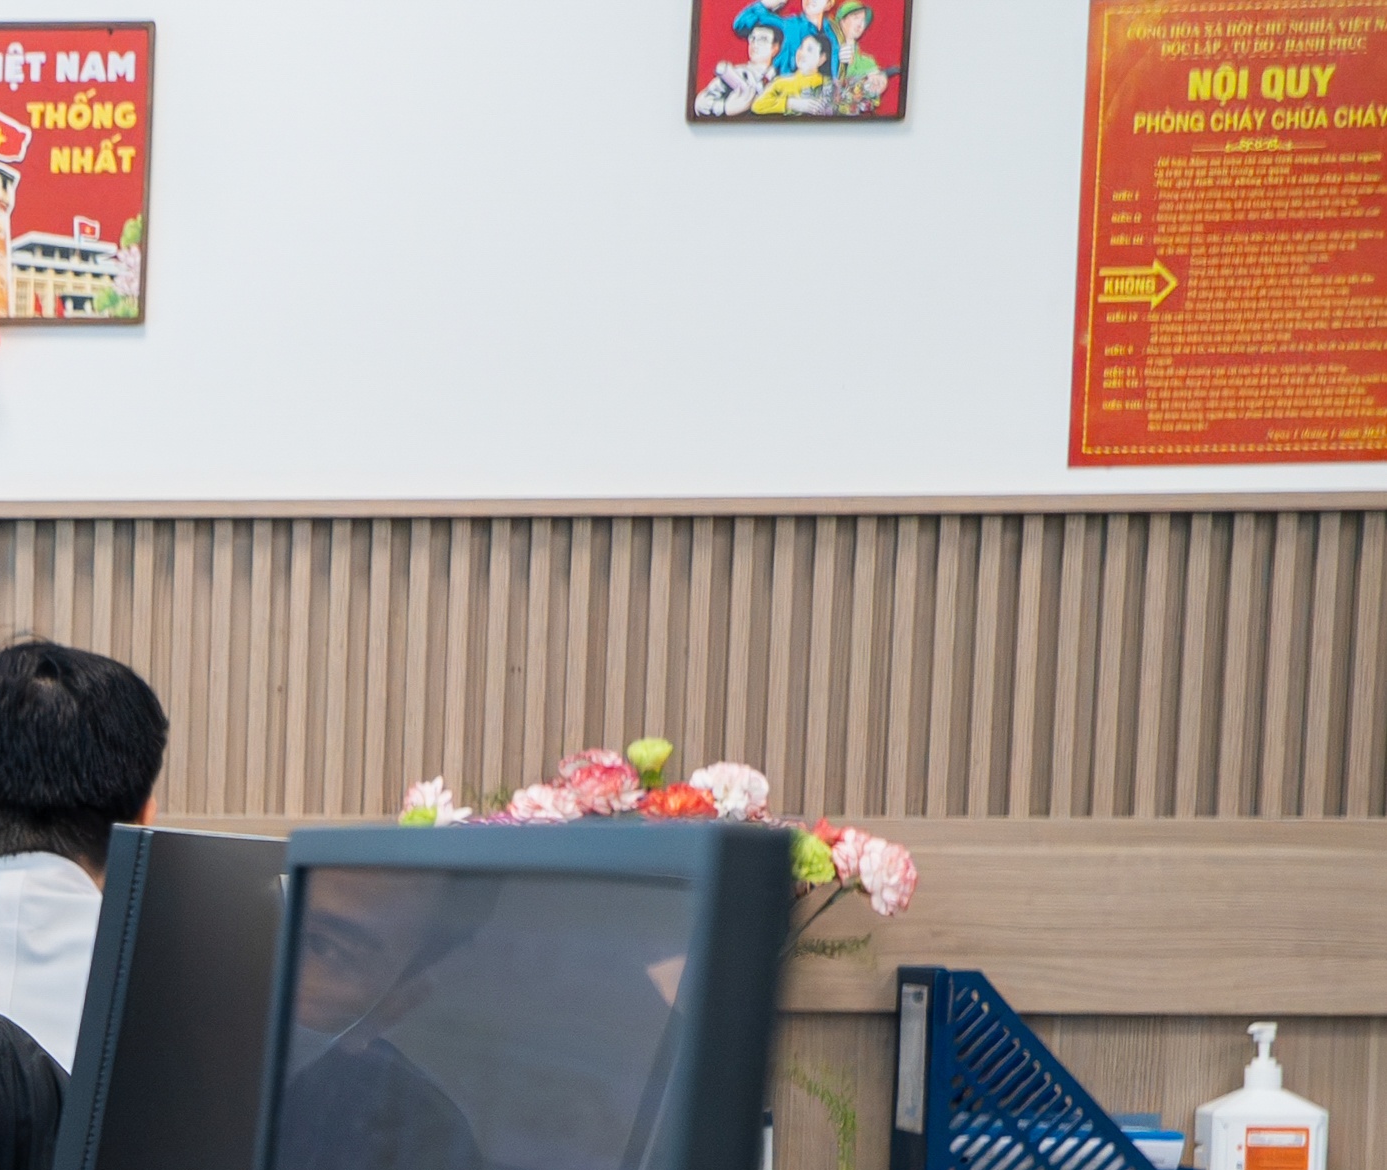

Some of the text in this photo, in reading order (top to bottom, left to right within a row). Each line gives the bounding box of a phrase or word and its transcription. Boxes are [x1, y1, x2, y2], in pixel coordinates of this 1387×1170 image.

[56, 51, 136, 83] NAM
[1188, 62, 1337, 107] NỘI QUY
[26, 87, 137, 130] THỐNG
[1133, 105, 1206, 135] PHÒNG
[1210, 105, 1267, 133] CHÁY
[1333, 100, 1387, 129] CHÁY
[50, 133, 137, 174] NHẤT
